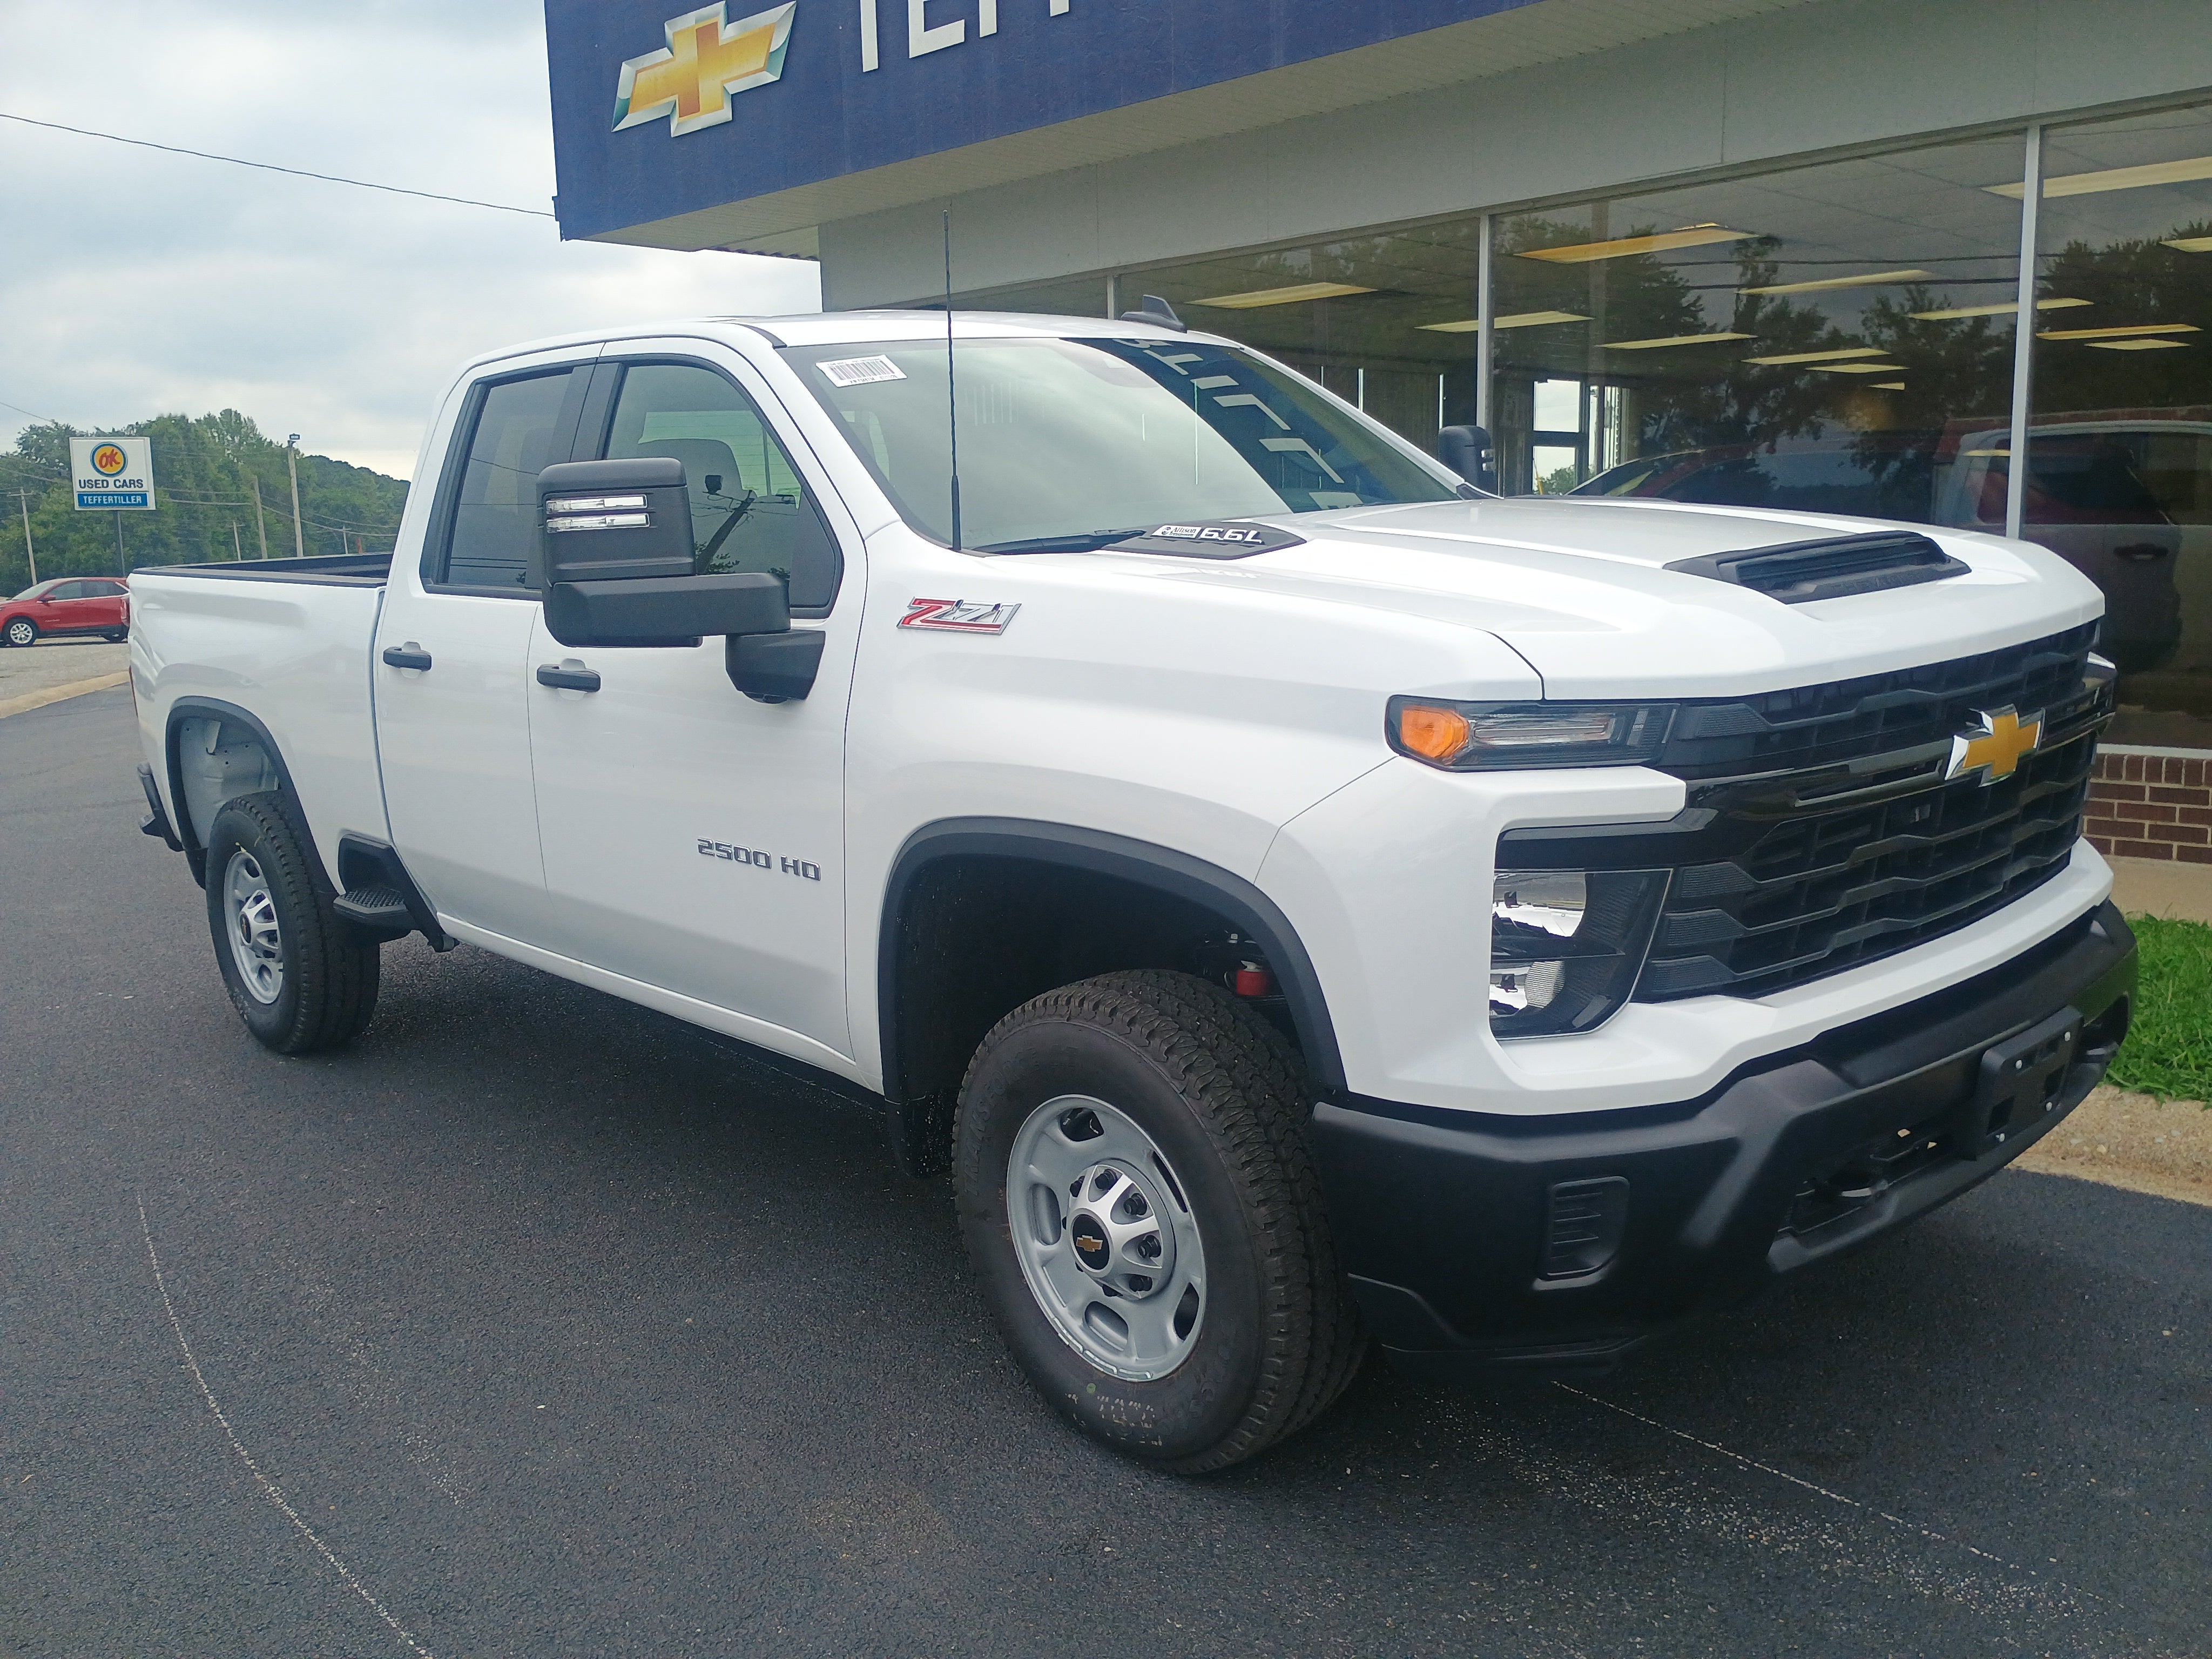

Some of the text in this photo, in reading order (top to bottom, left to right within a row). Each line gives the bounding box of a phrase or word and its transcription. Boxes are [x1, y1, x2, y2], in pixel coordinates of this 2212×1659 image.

[99, 449, 120, 468] OK
[78, 478, 144, 489] USED CARS
[83, 496, 142, 504] TEFFERTILLER
[1199, 527, 1264, 544] 6.6L
[897, 596, 1022, 636] Z71
[697, 837, 821, 881] 2500 HD
